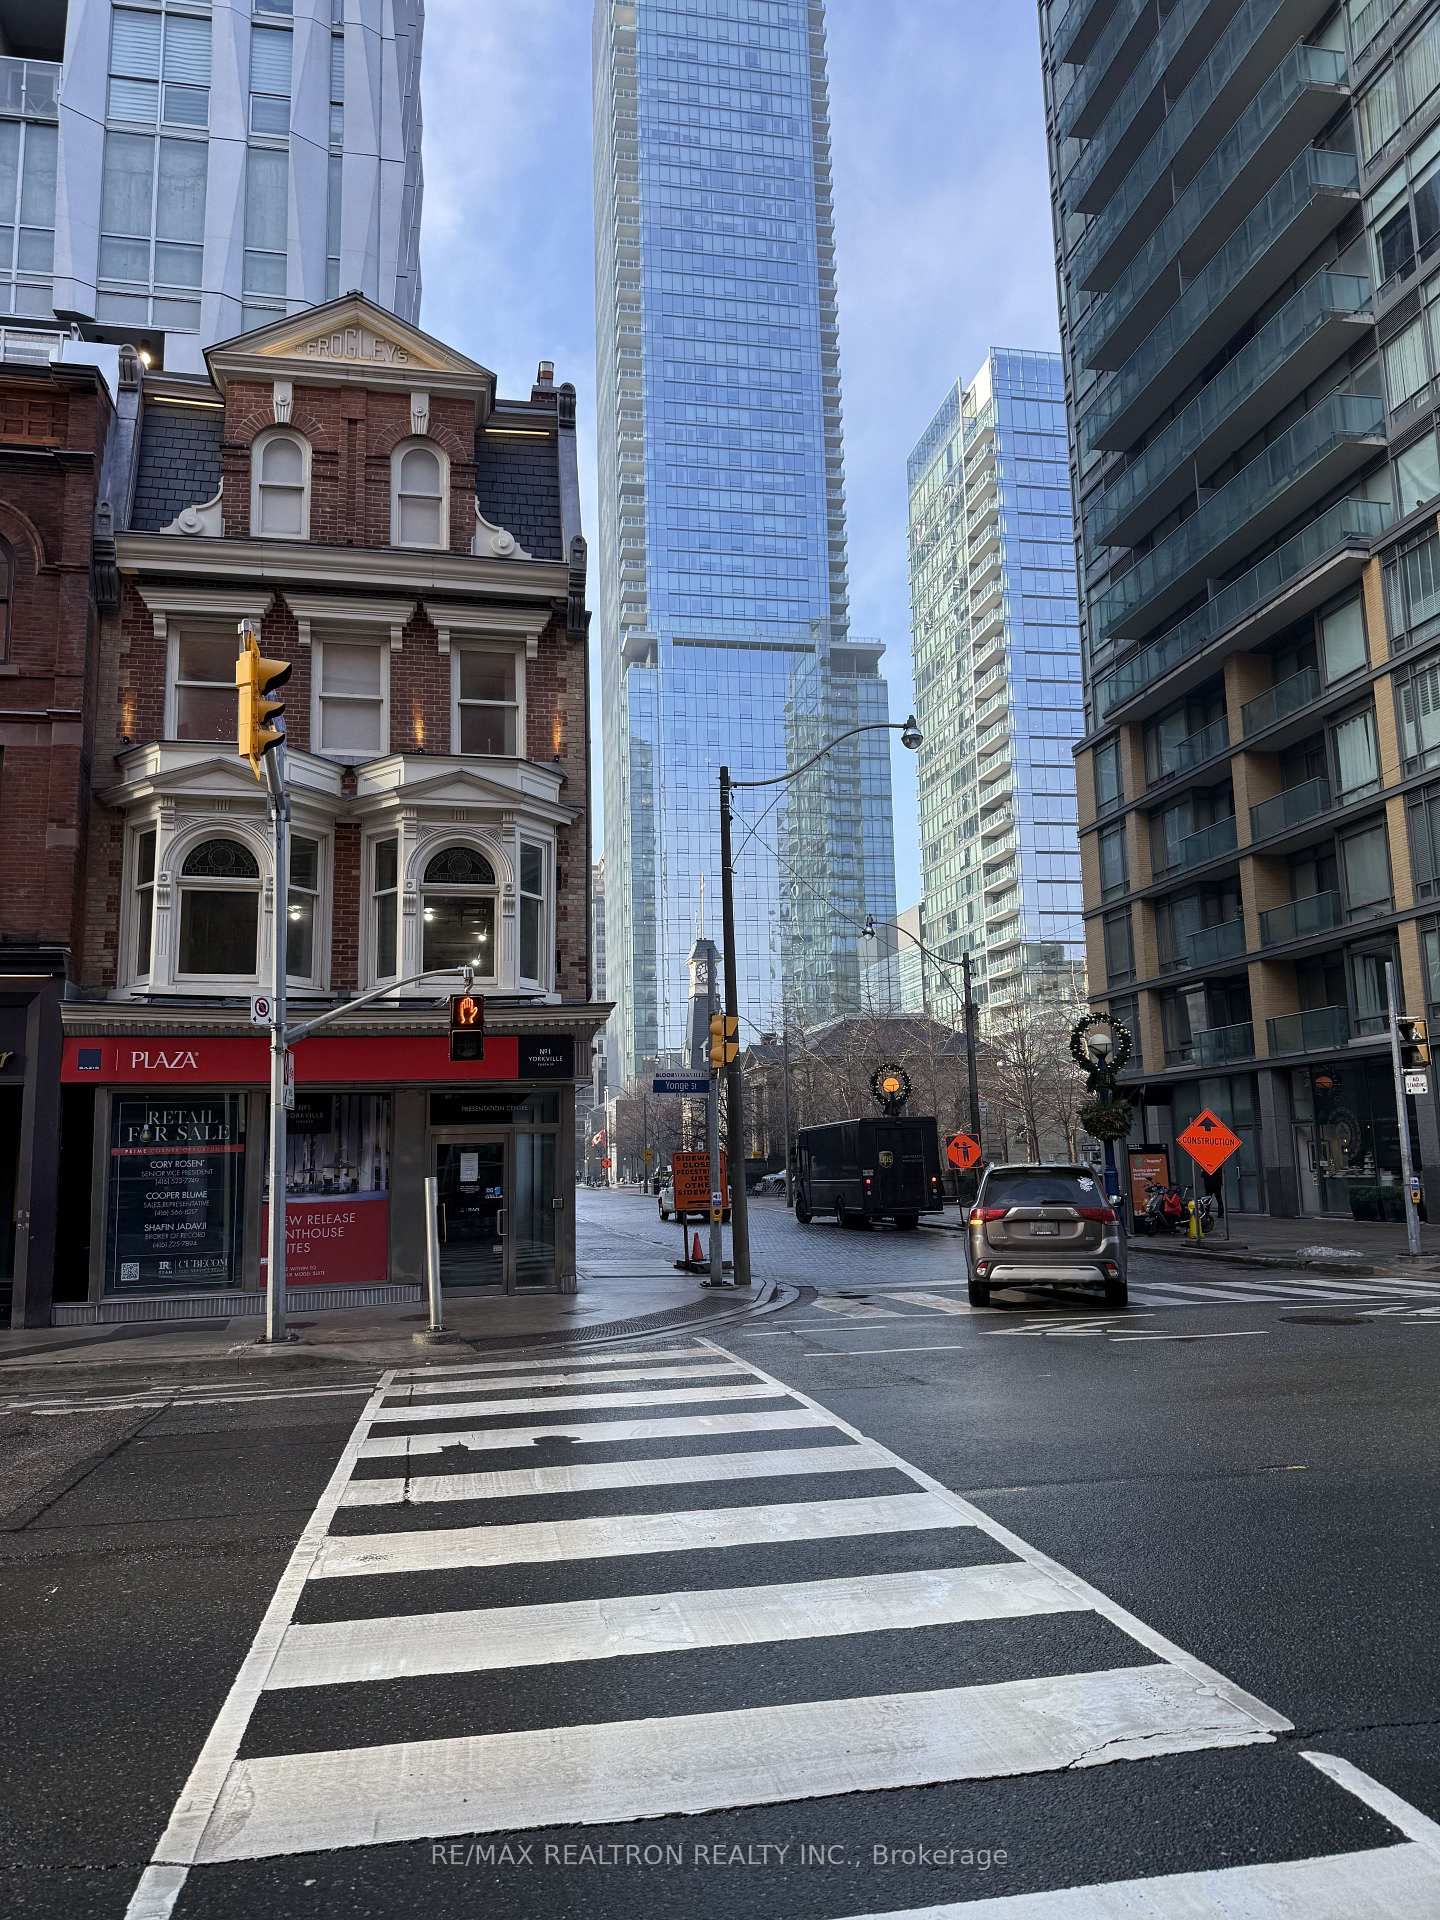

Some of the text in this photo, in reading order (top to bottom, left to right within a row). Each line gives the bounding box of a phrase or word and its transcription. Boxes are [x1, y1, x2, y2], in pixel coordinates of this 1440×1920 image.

[306, 328, 409, 363] FROGLEY'S
[665, 1081, 689, 1092] Yonge
[148, 1110, 219, 1125] RETAIL
[176, 1124, 230, 1141] SALE
[1182, 1136, 1235, 1146] CONSTRUCTION
[150, 1161, 173, 1169] CORY
[145, 1190, 208, 1200] COOPER BLUME
[307, 1212, 356, 1225] RELEASE
[144, 1223, 175, 1232] SHAFIN
